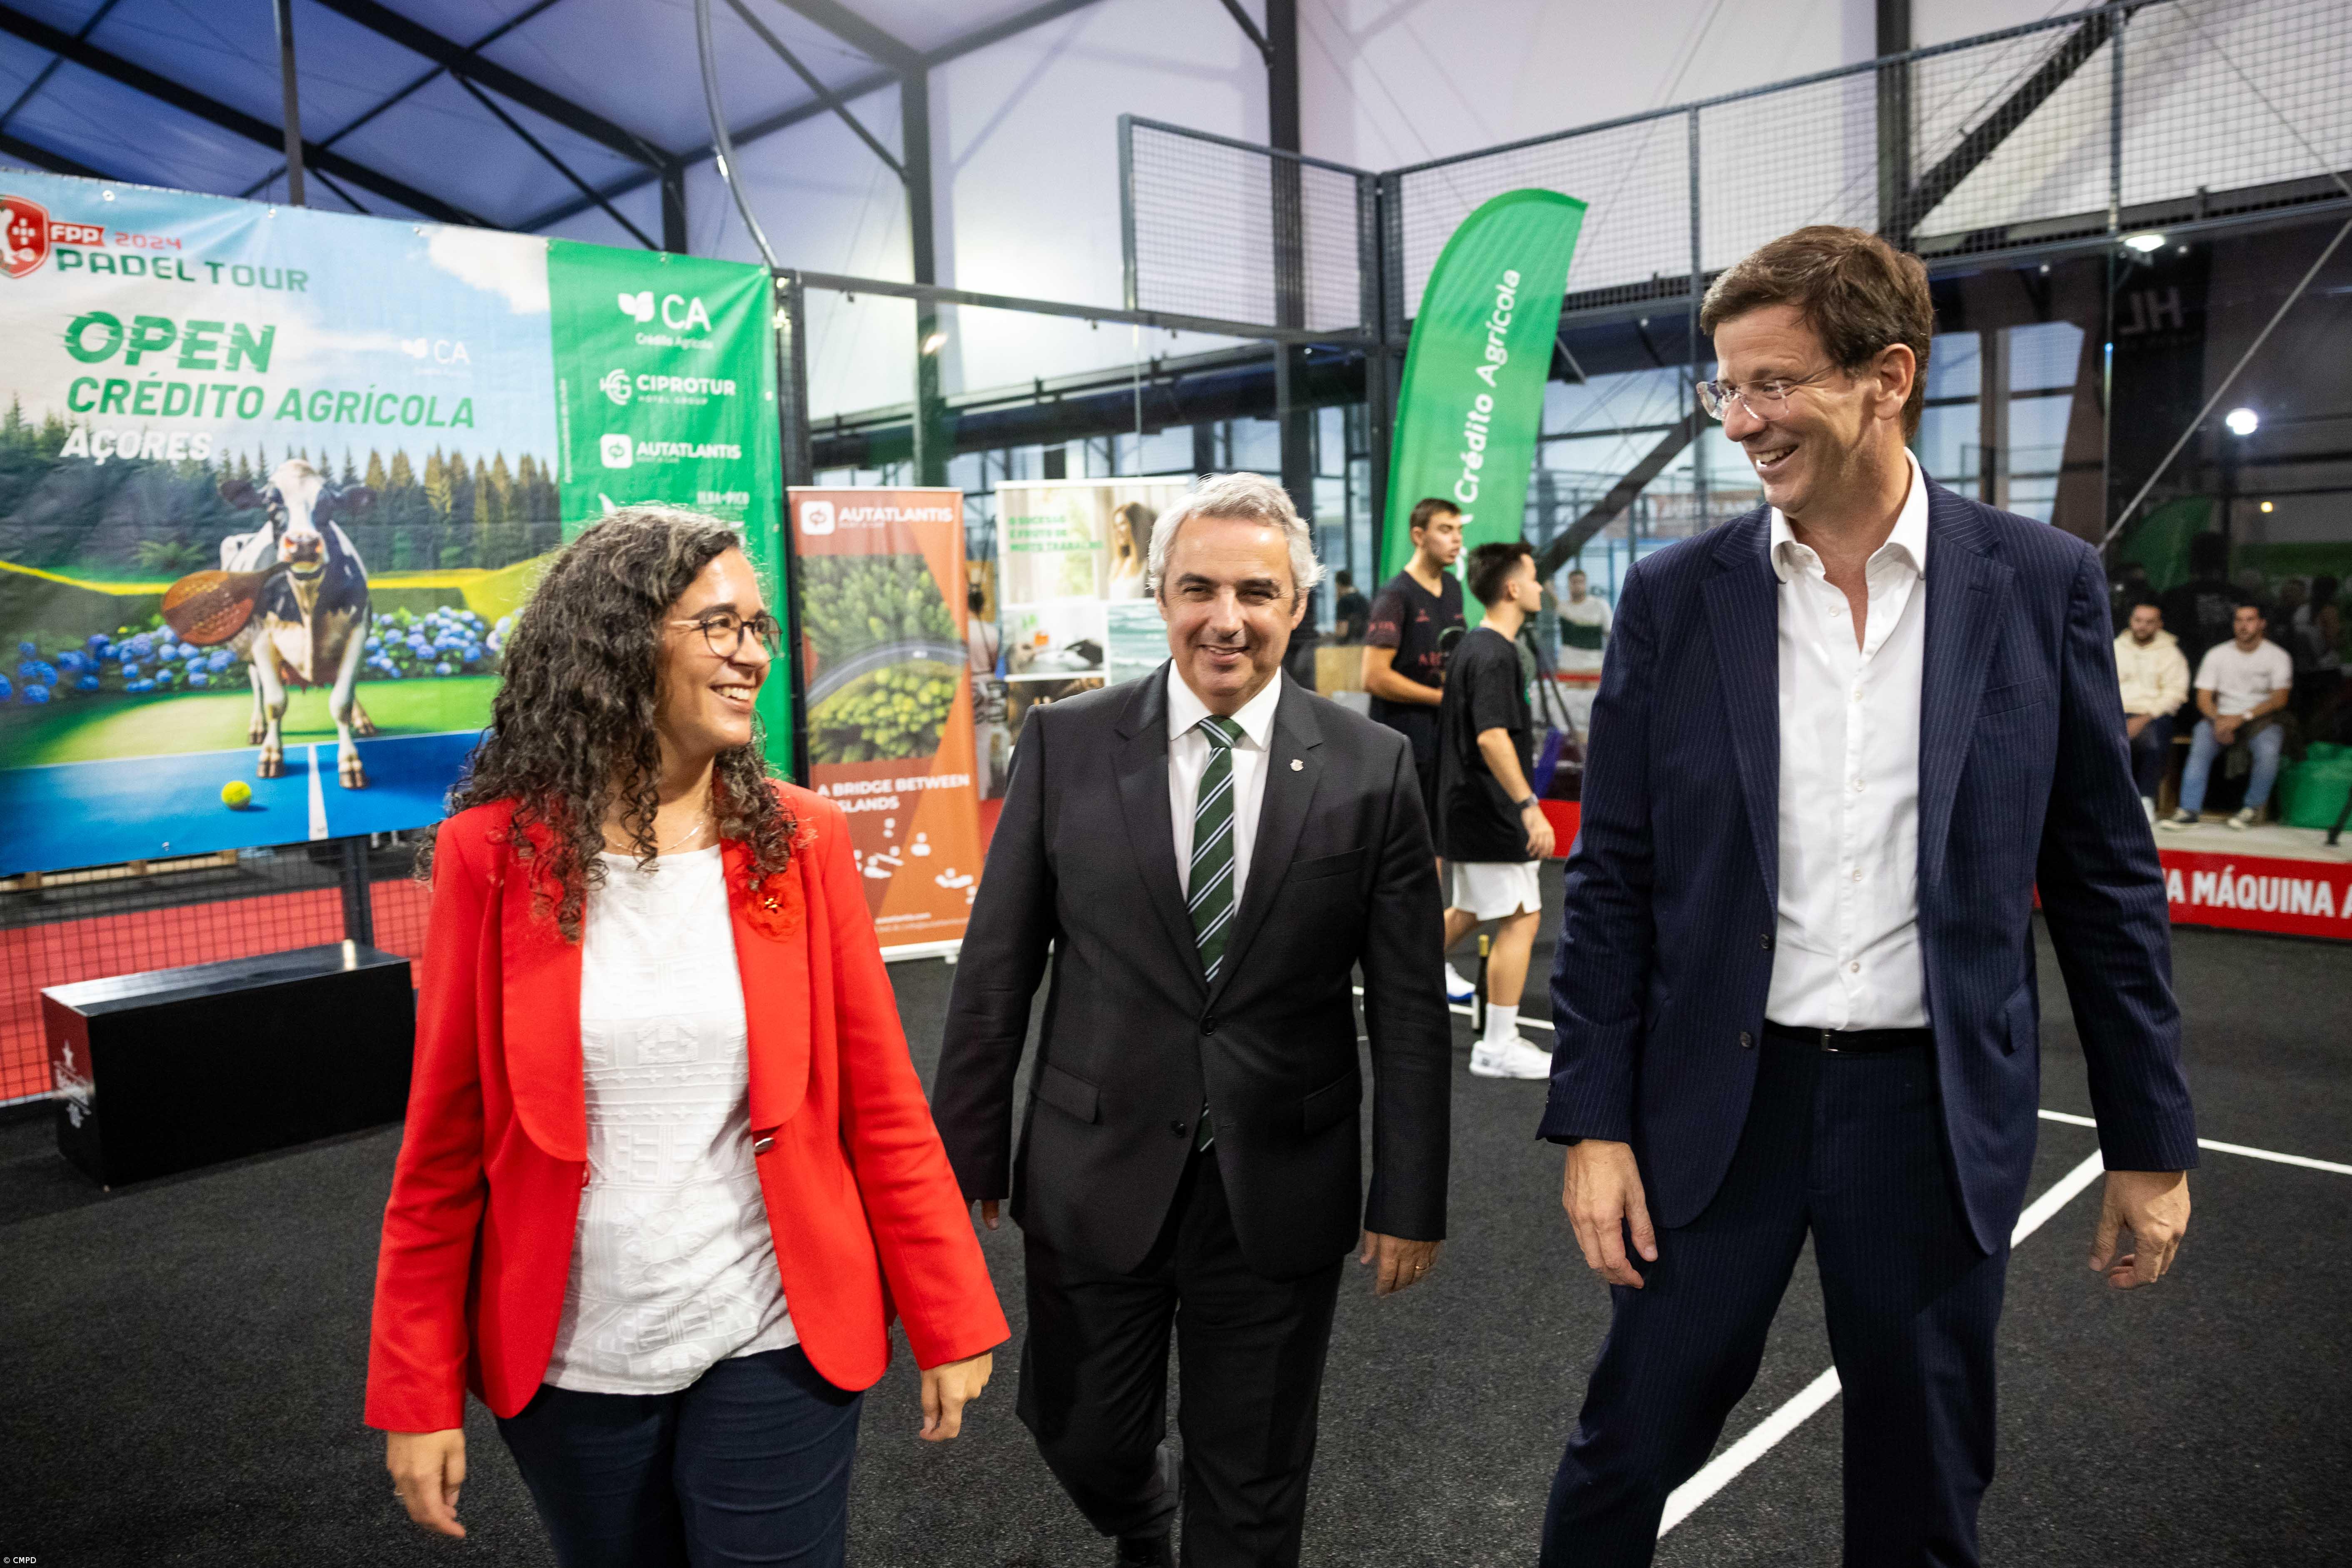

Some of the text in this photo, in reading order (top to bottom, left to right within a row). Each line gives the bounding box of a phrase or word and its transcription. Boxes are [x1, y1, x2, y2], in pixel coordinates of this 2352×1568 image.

[115, 232, 182, 250] 2024
[56, 249, 309, 292] PADEL TOUR
[661, 294, 711, 332] CA
[63, 311, 276, 374] OPEN
[434, 339, 471, 364] CA
[67, 372, 474, 429] CRÉDITO AGRÍCOLA
[636, 374, 736, 396] CIPROTUR
[1454, 394, 1494, 503] Crédito
[1476, 269, 1520, 388] Agrícola
[60, 428, 212, 465] AÇORES
[636, 441, 742, 459] AUTATLANTIS
[838, 507, 953, 522] AUTATLANTIS
[818, 774, 970, 797] A BRIDGE BETWEEN
[838, 795, 900, 813] SLANDS
[2192, 865, 2335, 917] MÁQUINA
